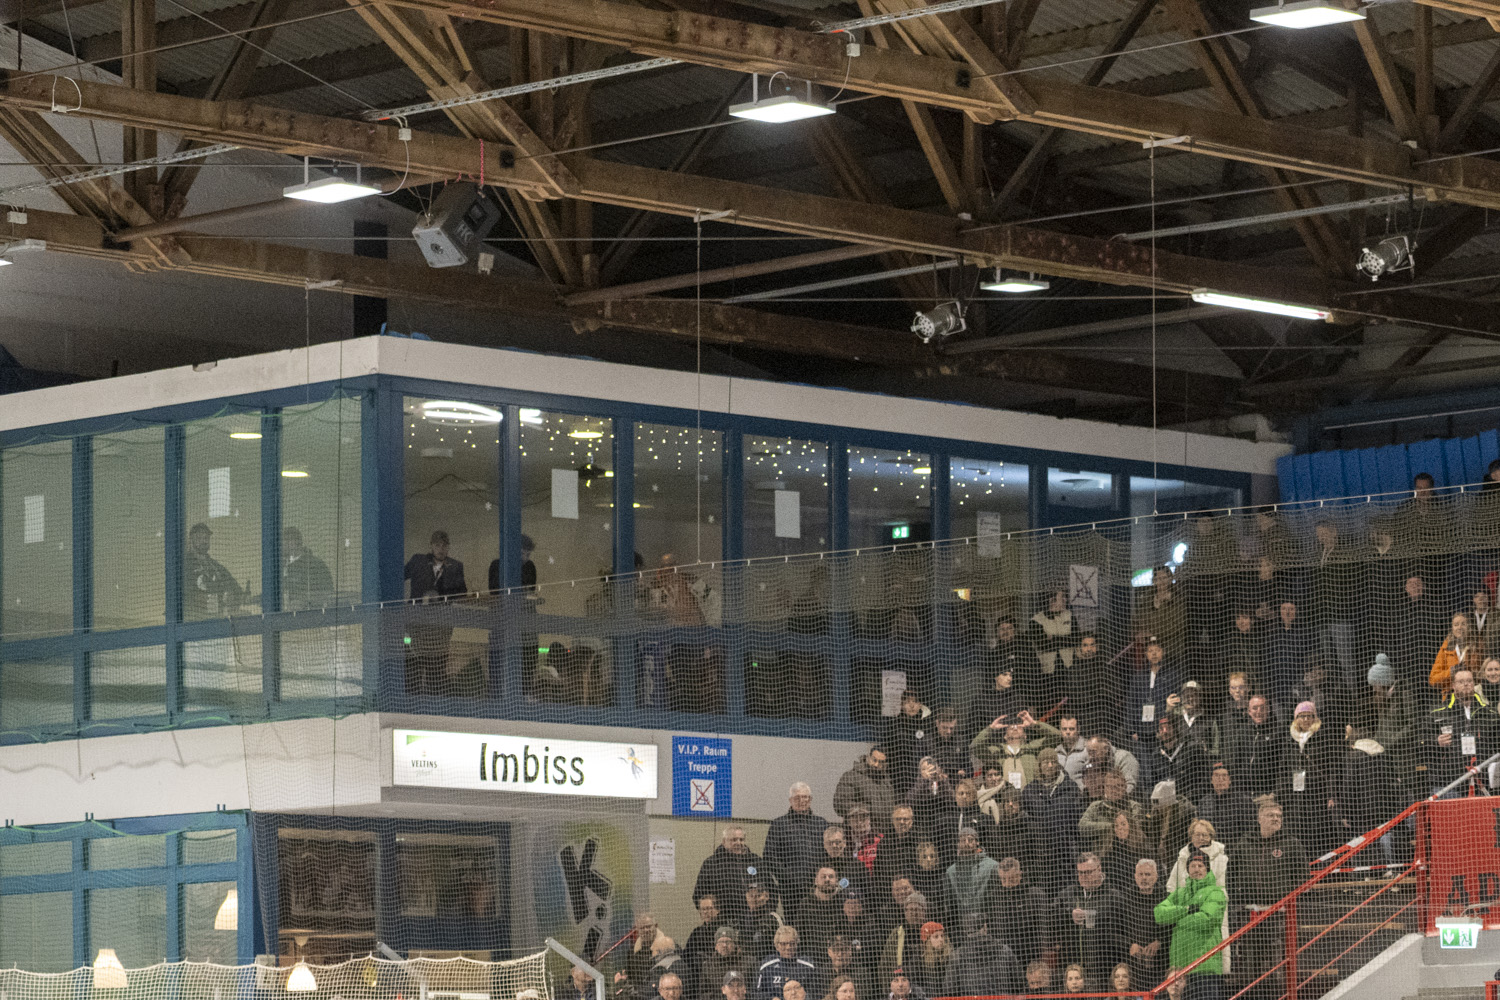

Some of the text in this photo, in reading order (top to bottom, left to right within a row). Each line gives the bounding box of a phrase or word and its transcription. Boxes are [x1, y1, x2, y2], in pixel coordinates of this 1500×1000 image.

[678, 744, 728, 756] V.I.P. Raum
[411, 760, 438, 769] VELTINS
[479, 742, 586, 787] Imbiss
[688, 761, 718, 775] Treppe
